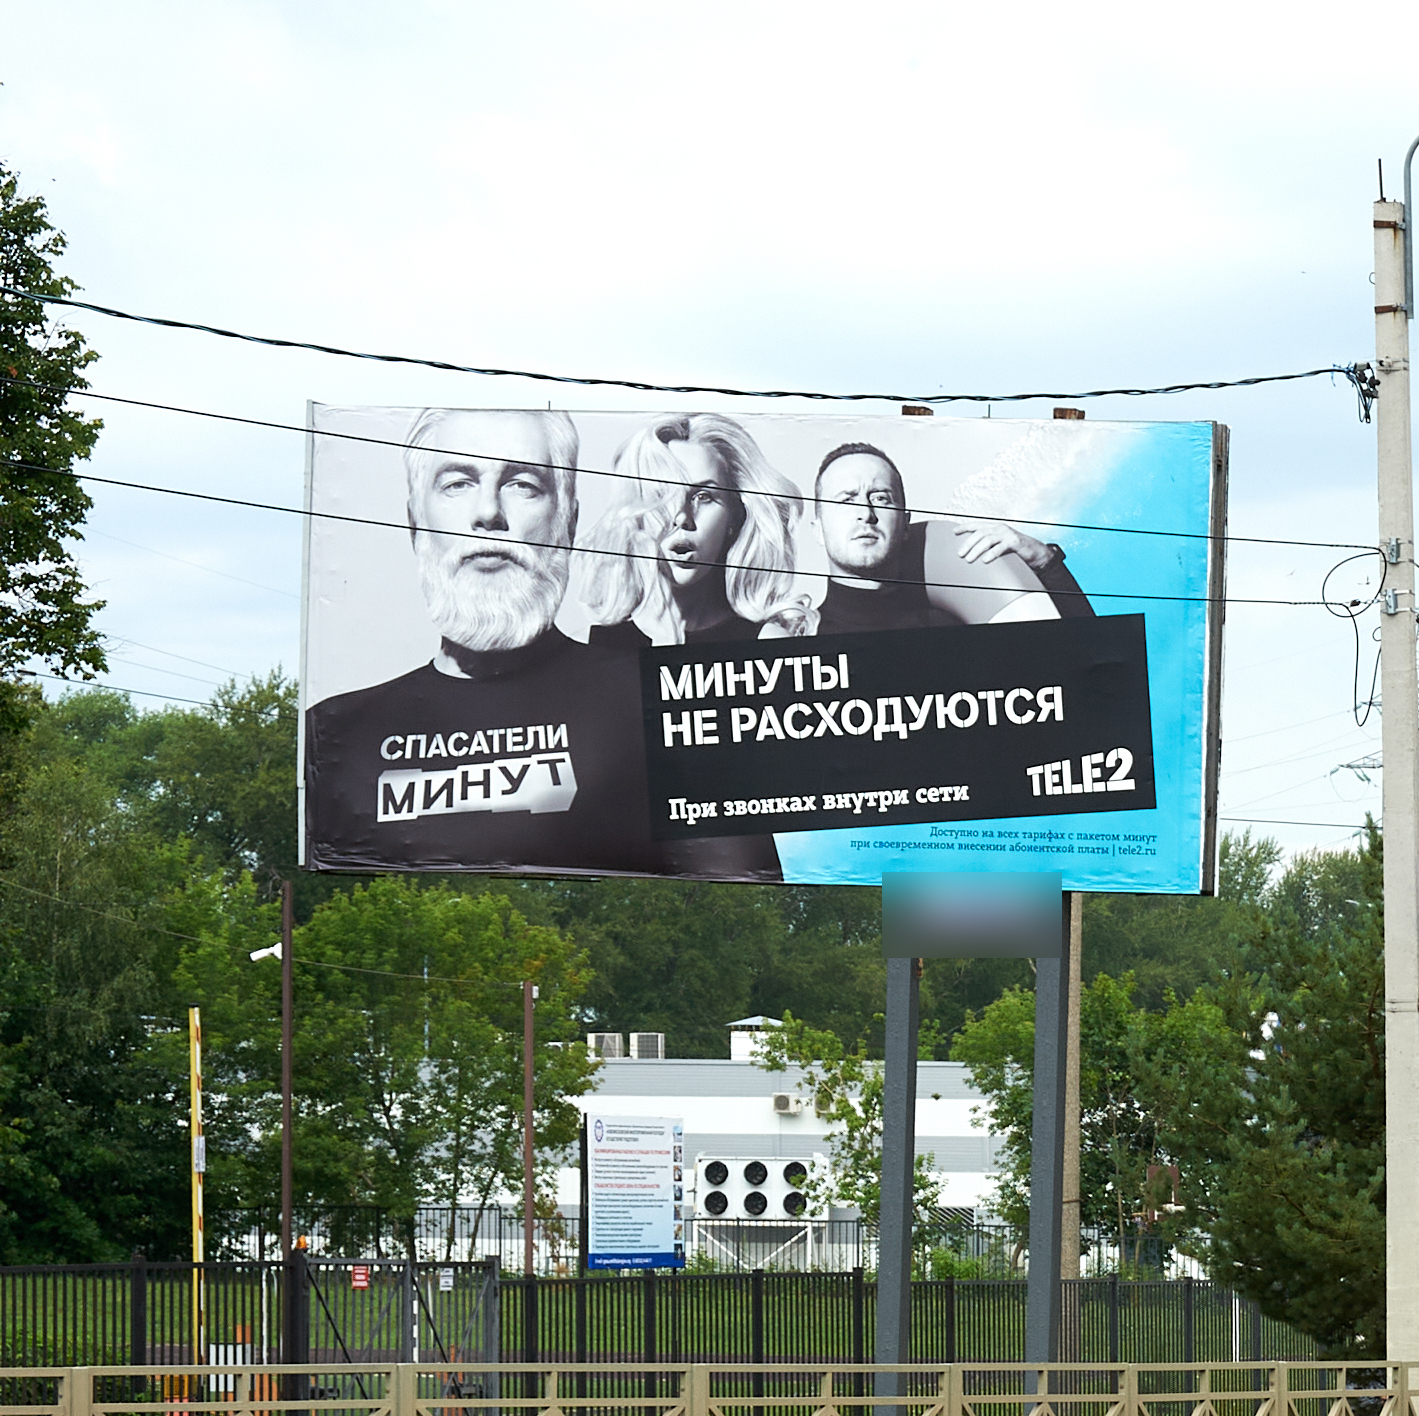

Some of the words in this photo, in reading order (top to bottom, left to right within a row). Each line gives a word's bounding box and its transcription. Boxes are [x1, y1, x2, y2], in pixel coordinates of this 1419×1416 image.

[659, 653, 850, 701] МИНУТЫ
[661, 708, 720, 748] НЕ
[731, 685, 1065, 743] РАСХОДУЮТСЯ
[379, 723, 569, 761] СПАСАТЕЛИ
[382, 758, 566, 816] МИНУТ
[1026, 747, 1136, 797] TELE2
[668, 797, 718, 825] При
[723, 794, 817, 817] звонках
[822, 788, 910, 814] внутри
[915, 784, 970, 804] сети
[850, 840, 871, 851] при
[873, 841, 955, 852] своевременном
[958, 842, 1007, 852] внесении
[1009, 842, 1075, 854] абонентской
[1077, 845, 1109, 855] платы
[1118, 844, 1157, 856] tele2.ru
[930, 826, 979, 840] Доступно
[981, 830, 994, 839] на
[997, 830, 1020, 839] всех
[1022, 829, 1066, 842] тарифах
[1068, 832, 1074, 840] с
[1076, 832, 1120, 841] пакетом
[1123, 834, 1158, 845] минут
